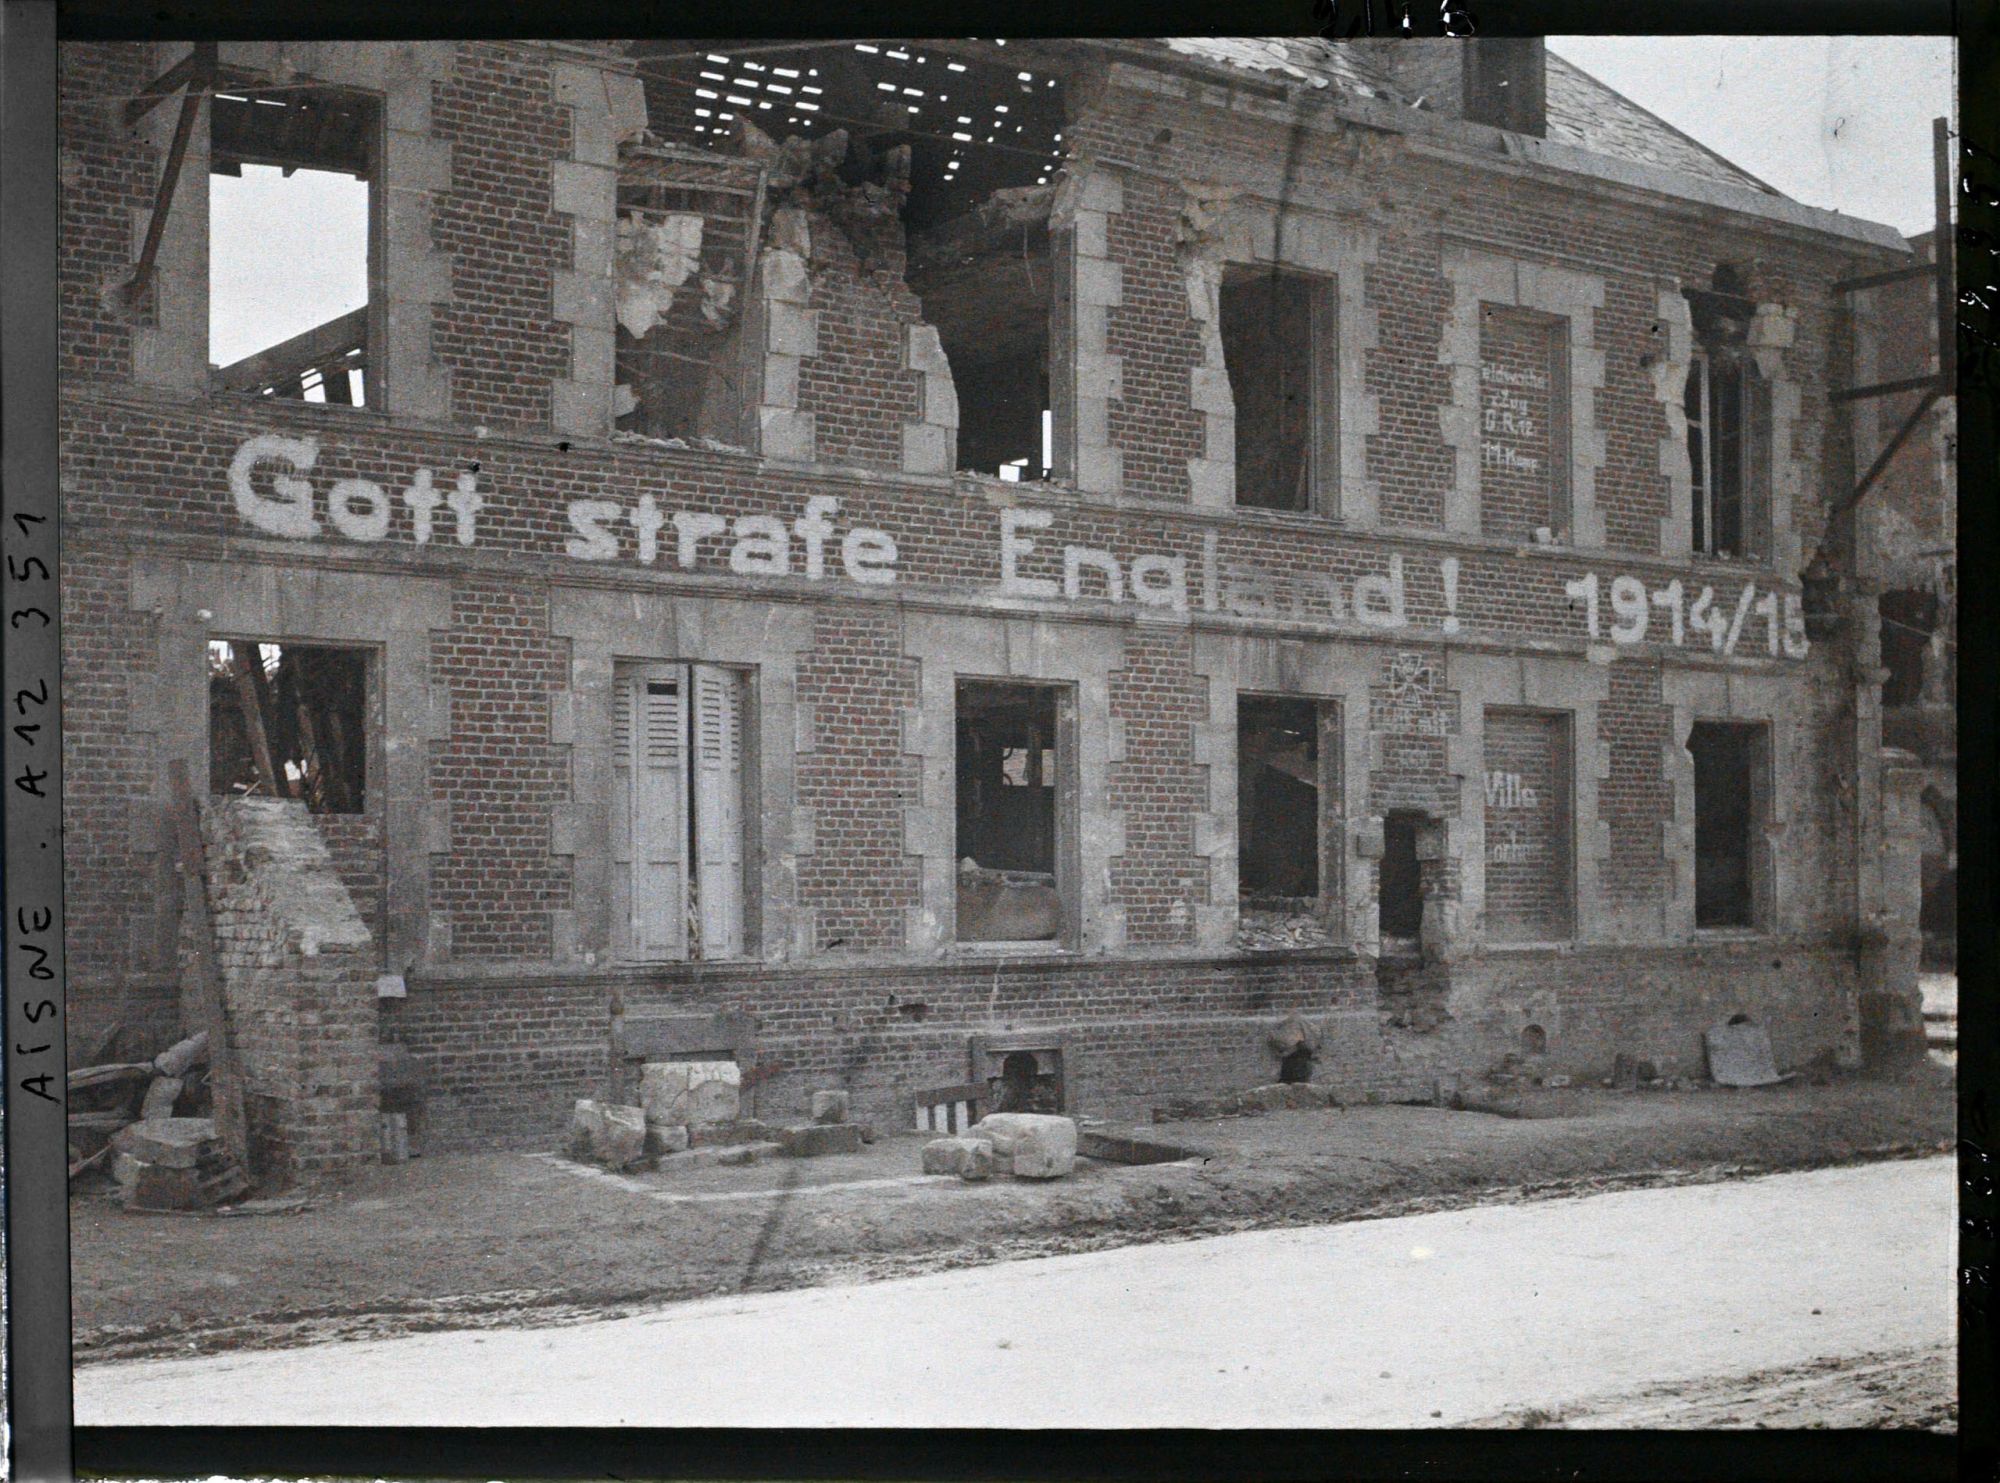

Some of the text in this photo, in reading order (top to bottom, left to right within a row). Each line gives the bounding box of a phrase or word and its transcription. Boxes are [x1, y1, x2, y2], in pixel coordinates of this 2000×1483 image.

[228, 434, 483, 546] Gott
[566, 494, 898, 584] strafe
[18, 905, 61, 1104] AISNE
